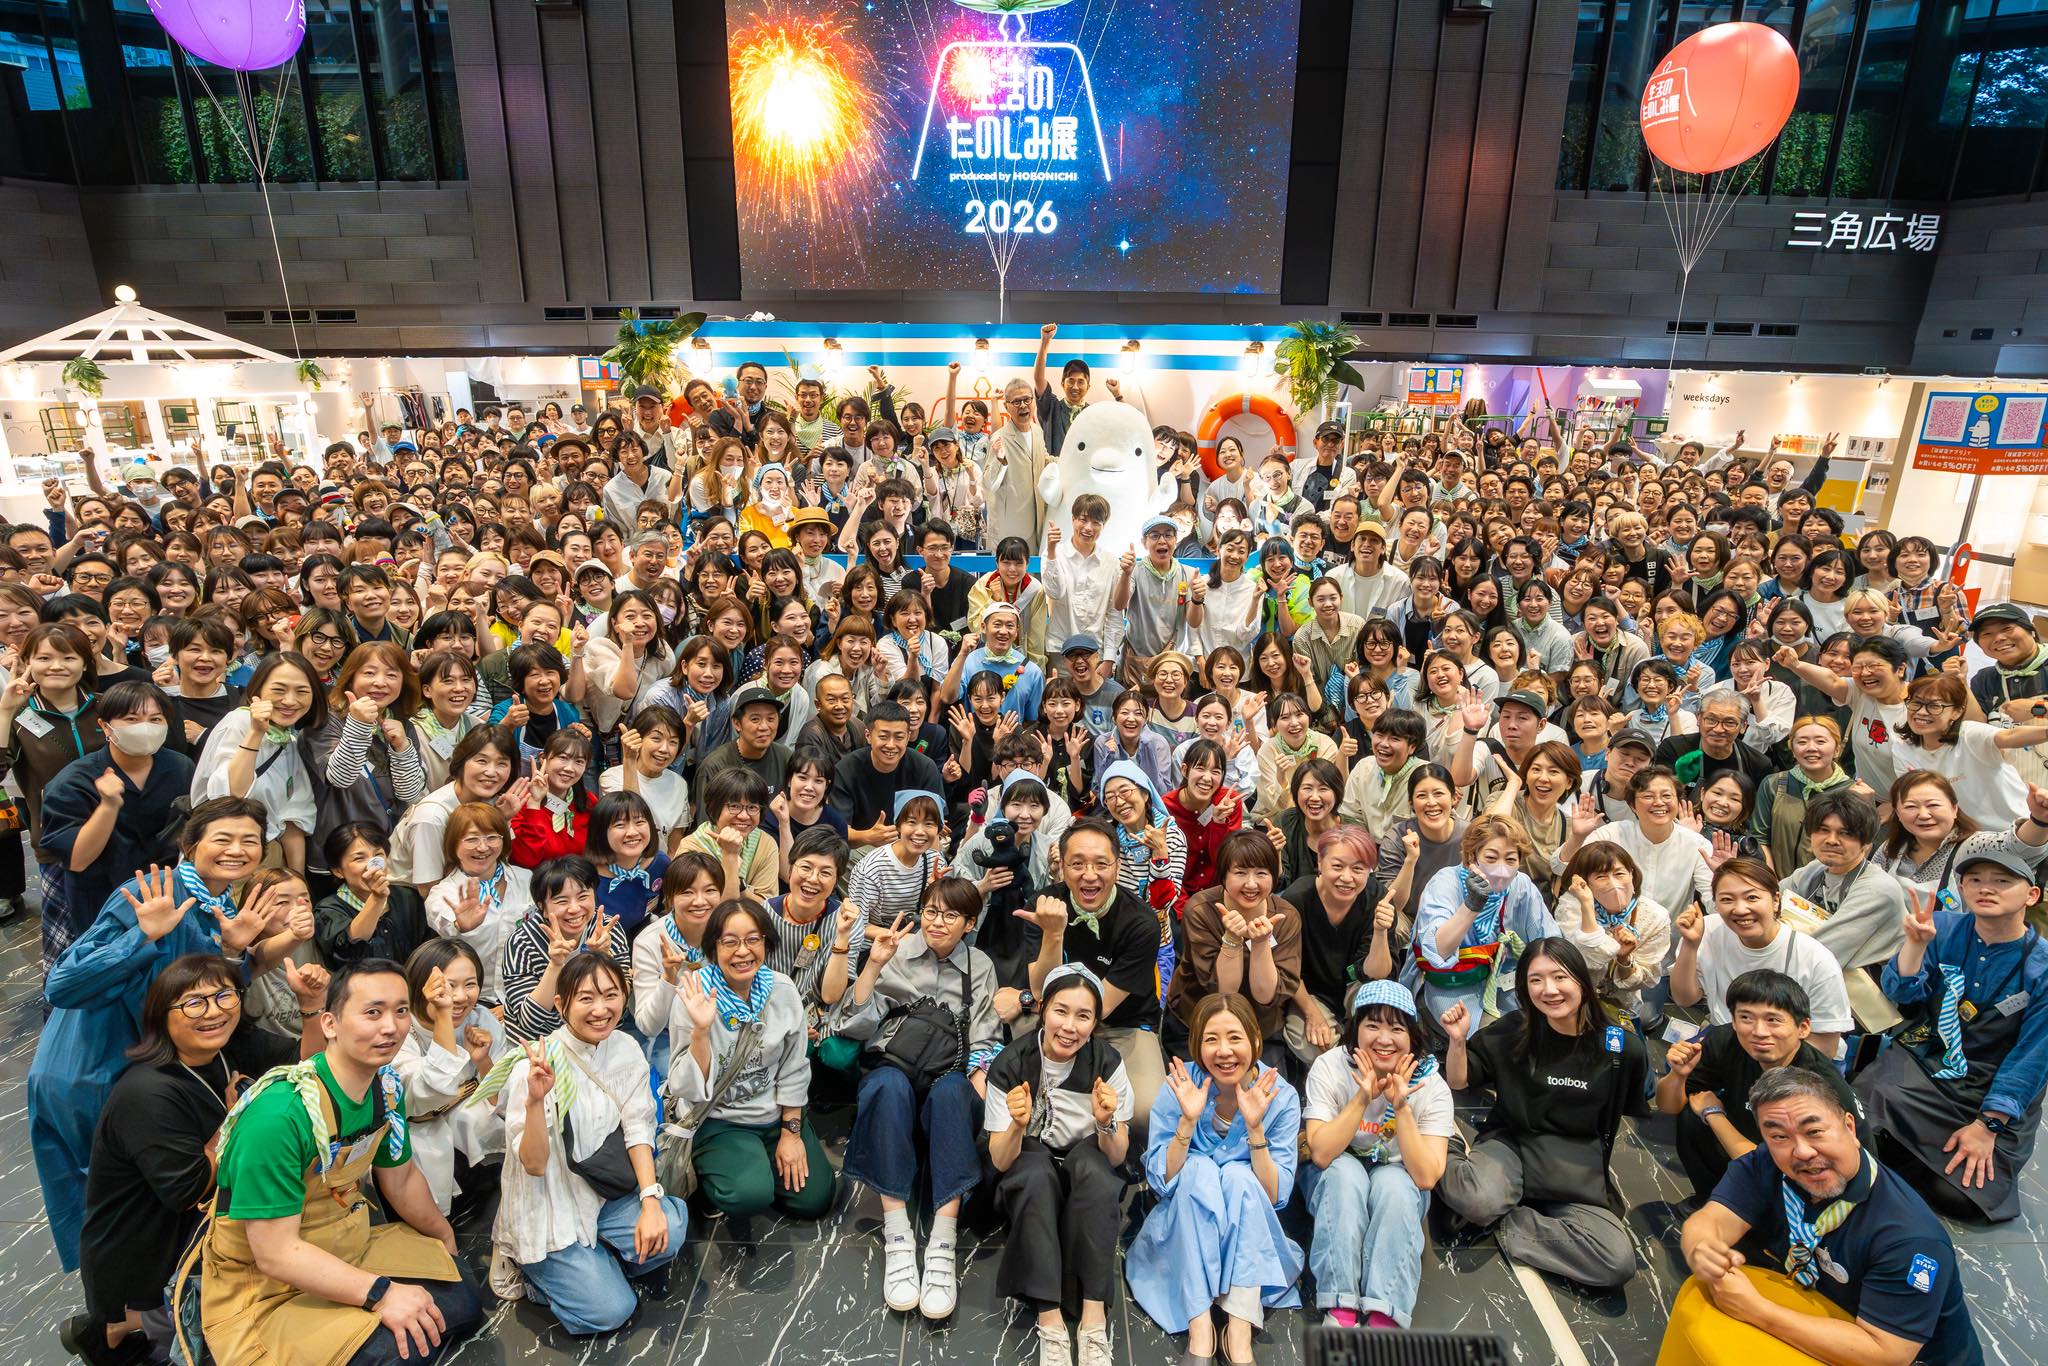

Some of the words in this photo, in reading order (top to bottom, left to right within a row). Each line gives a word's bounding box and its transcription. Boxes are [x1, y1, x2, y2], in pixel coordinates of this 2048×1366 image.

[946, 115, 1078, 160] たのしみ展
[950, 172, 997, 182] produced
[998, 172, 1012, 182] by
[1013, 172, 1078, 181] HOBONICHI
[965, 200, 1058, 233] 2026
[1788, 211, 1941, 251] 三角広場
[1683, 393, 1730, 405] weeksdays
[1547, 1075, 1588, 1090] toolbox
[1915, 1259, 1936, 1271] STAFF
